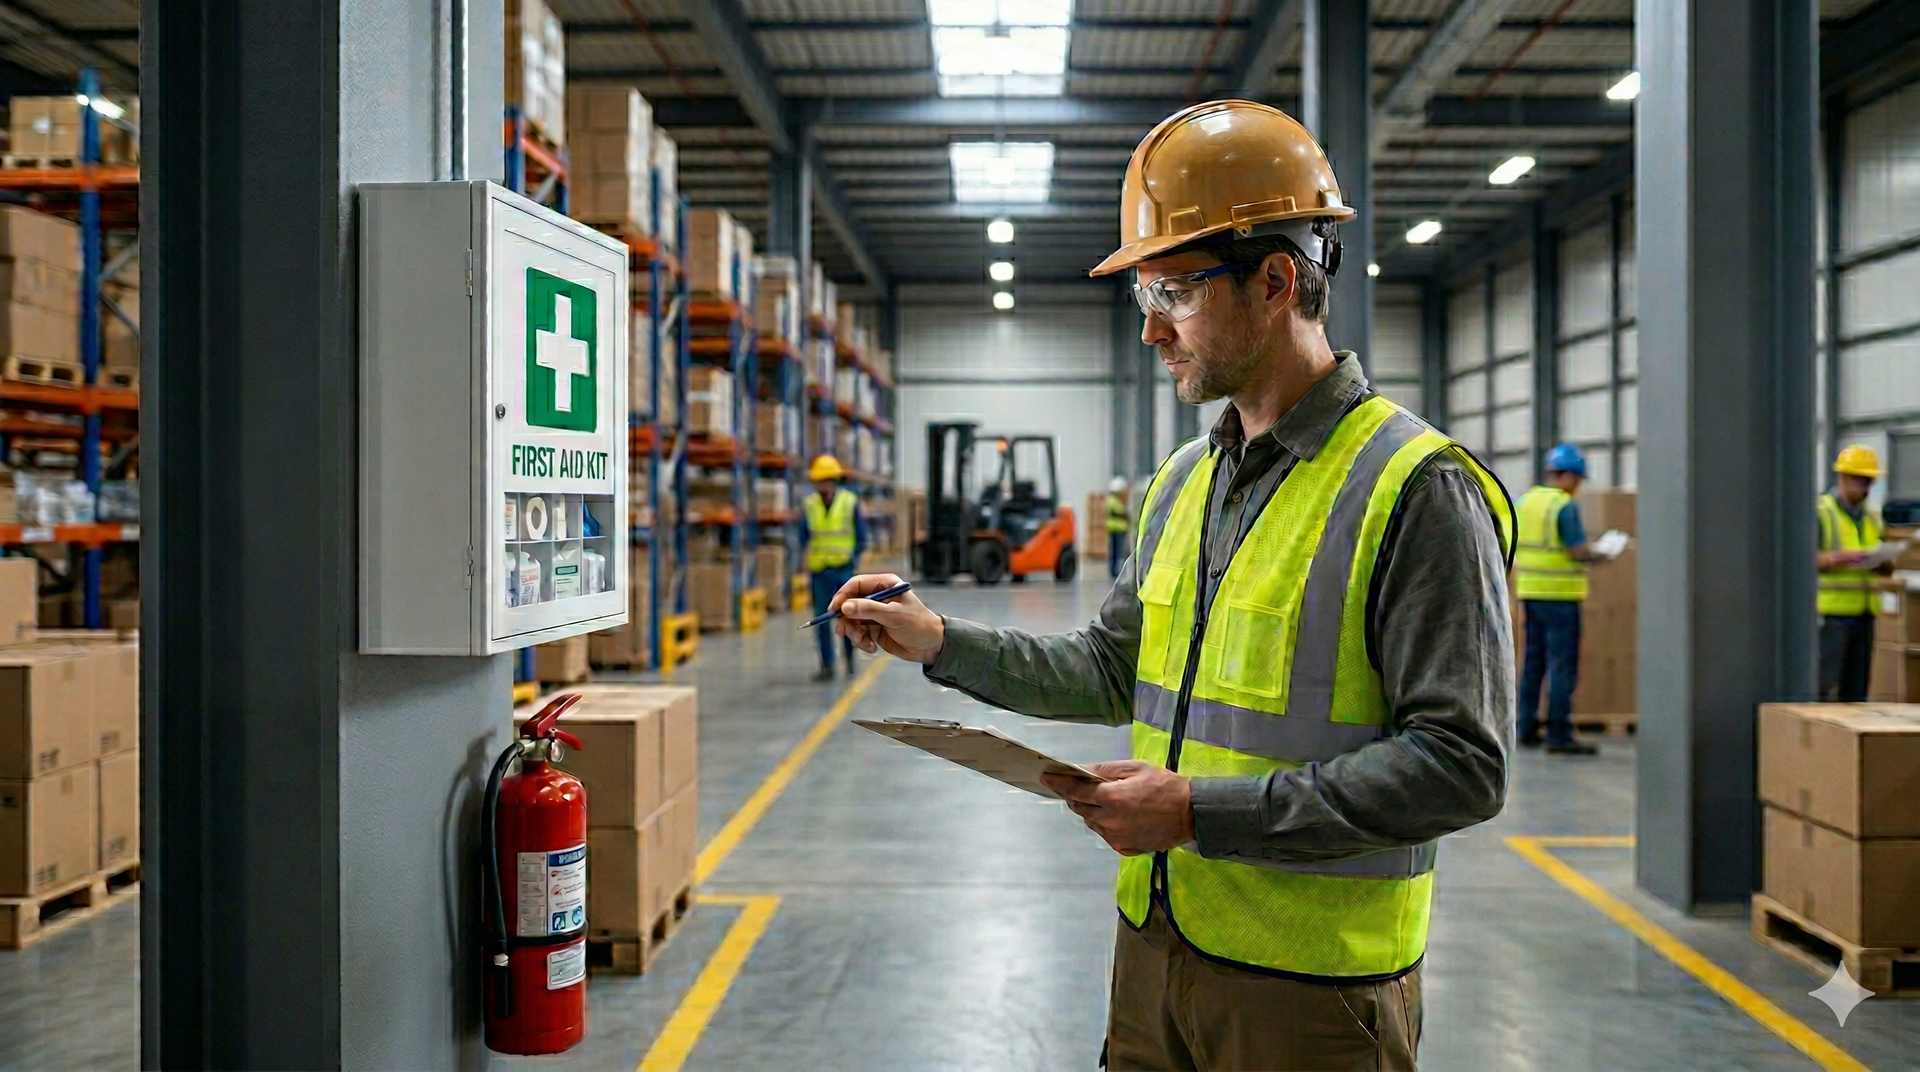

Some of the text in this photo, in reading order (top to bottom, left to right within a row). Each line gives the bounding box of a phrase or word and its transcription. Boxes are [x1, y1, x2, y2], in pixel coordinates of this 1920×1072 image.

[512, 444, 608, 480] FIRST AID KIT
